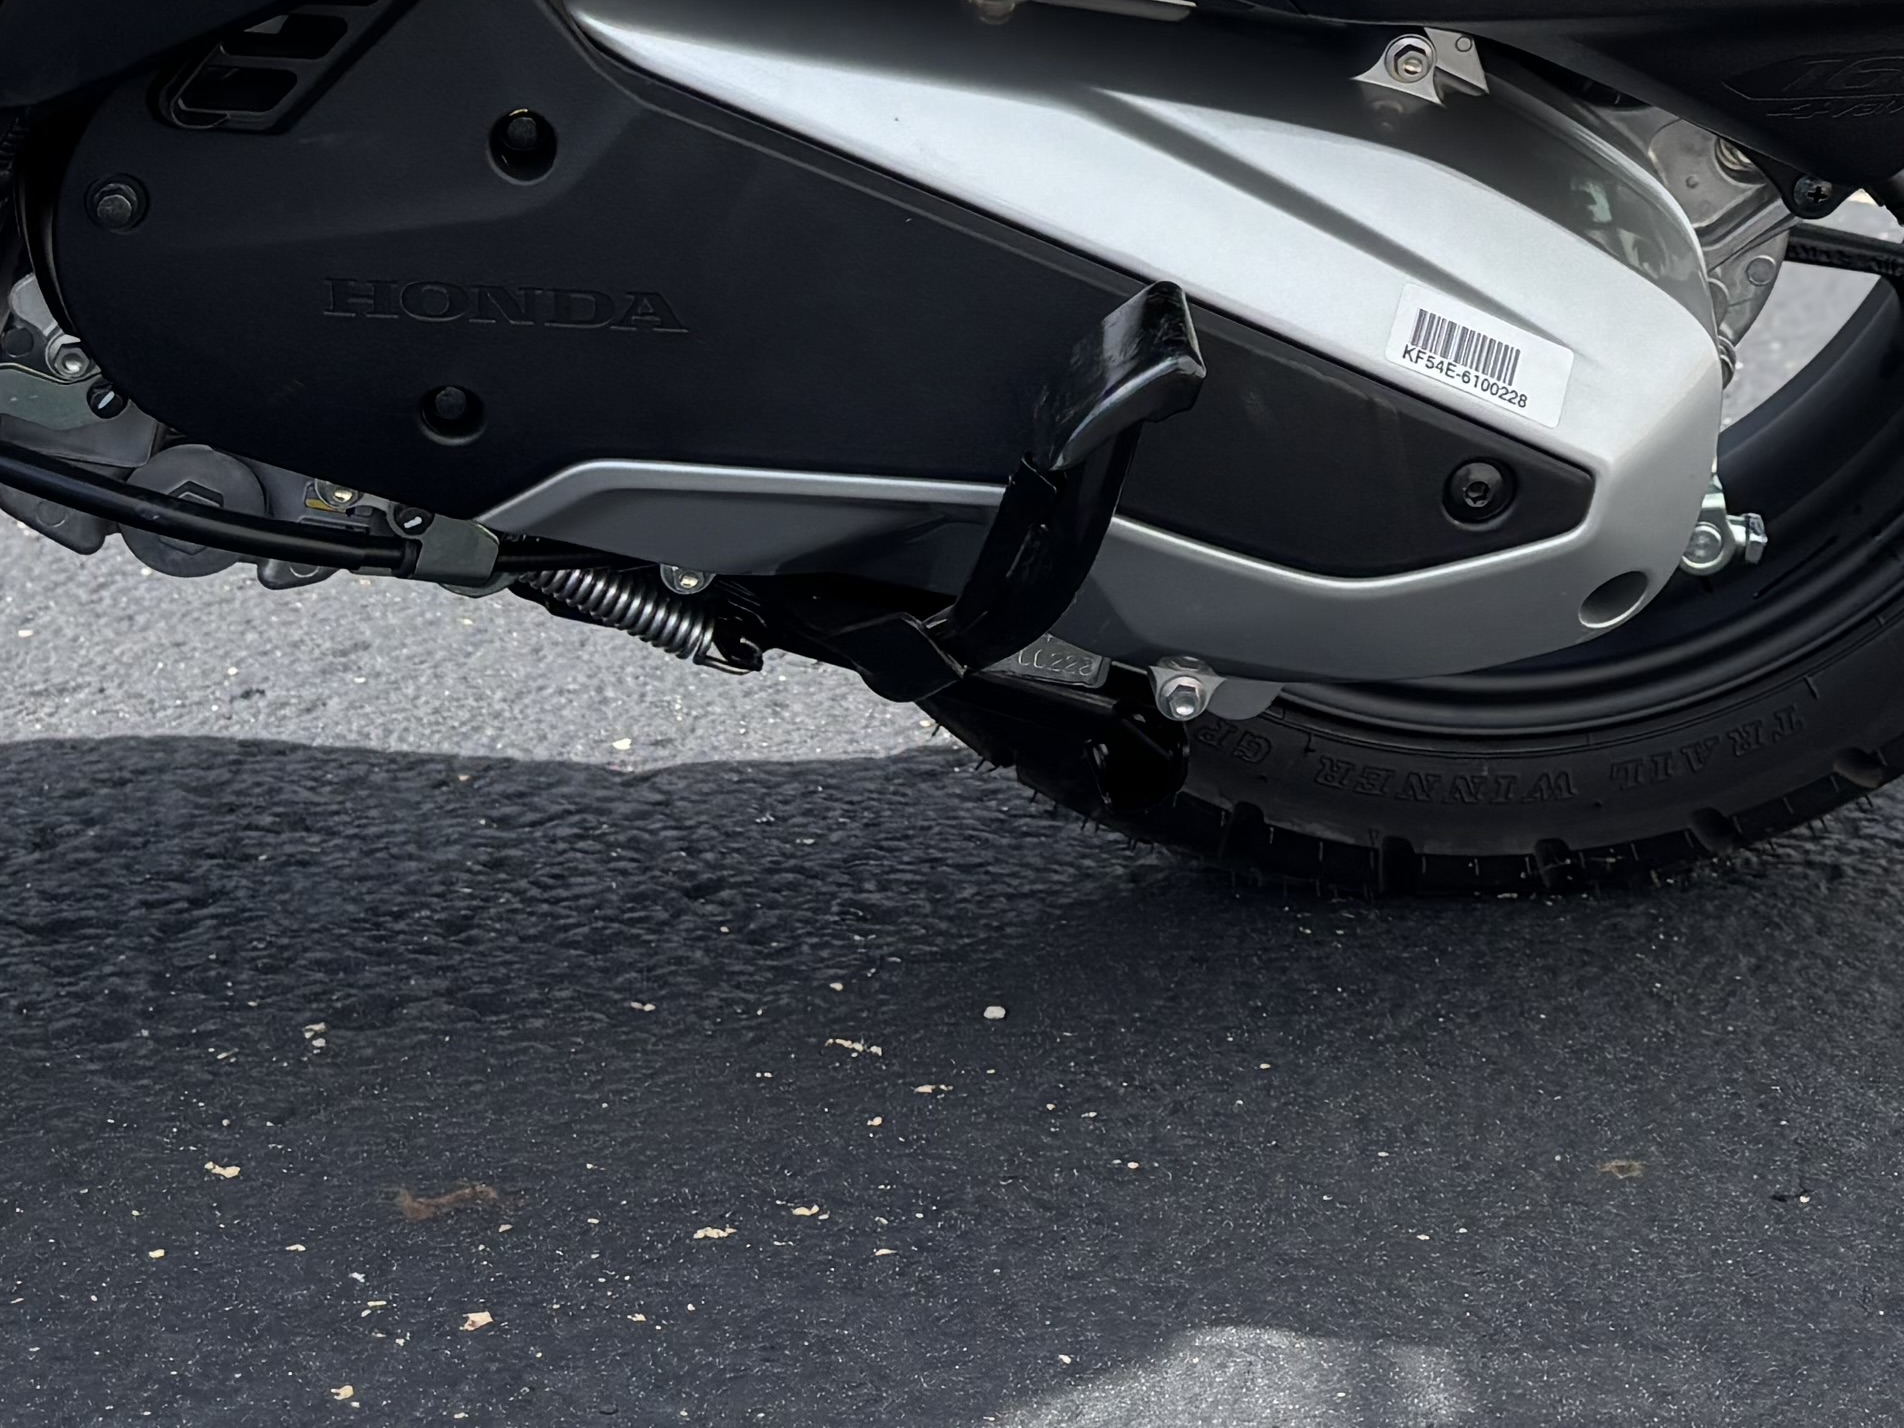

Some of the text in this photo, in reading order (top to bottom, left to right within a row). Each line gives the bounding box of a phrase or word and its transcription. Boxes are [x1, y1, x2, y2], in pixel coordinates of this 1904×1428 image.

[322, 277, 690, 333] HONDA
[1402, 344, 1528, 408] KF54E-6100228
[1608, 704, 1805, 794] TRAIL
[1311, 756, 1578, 806] WINNER
